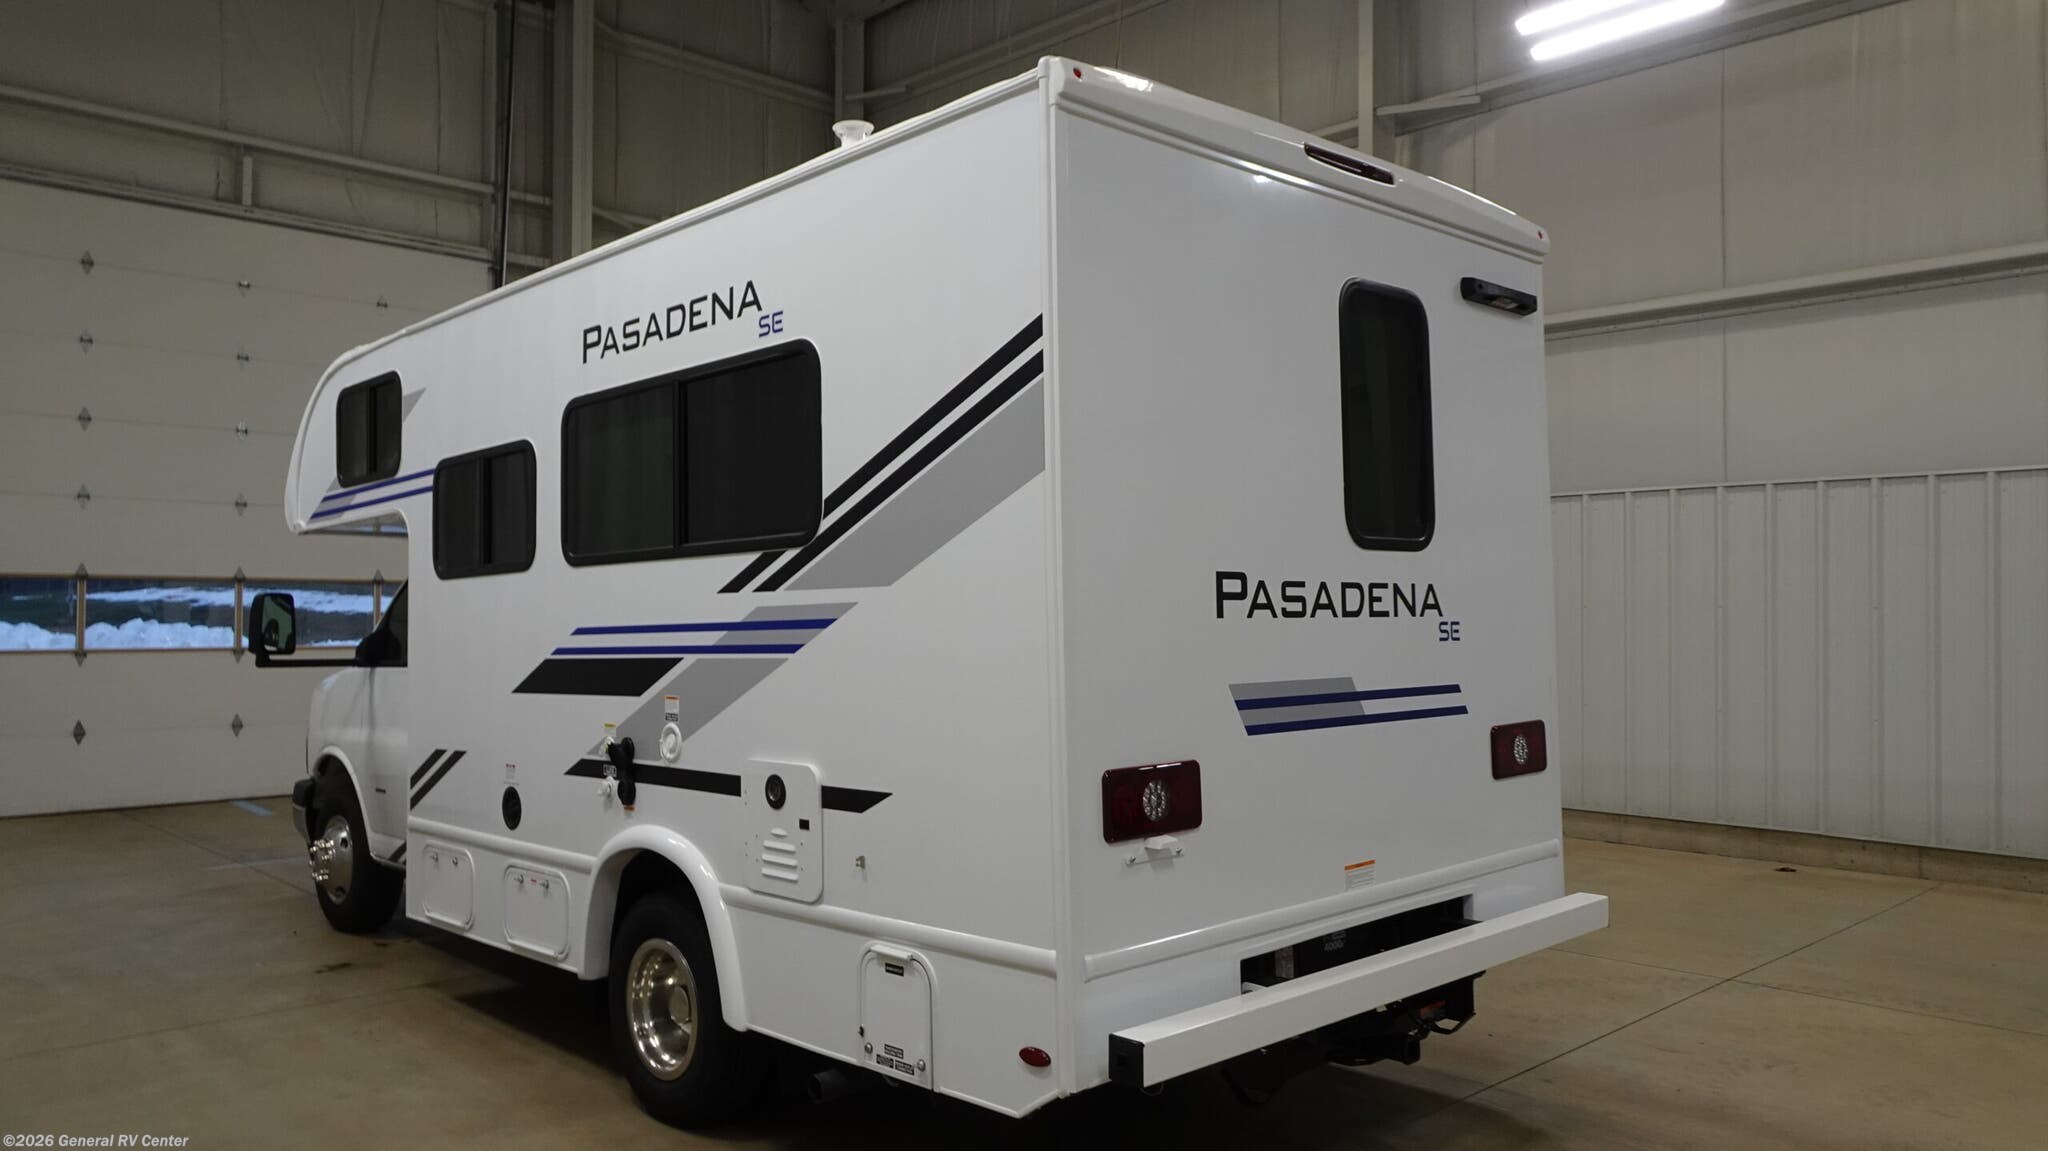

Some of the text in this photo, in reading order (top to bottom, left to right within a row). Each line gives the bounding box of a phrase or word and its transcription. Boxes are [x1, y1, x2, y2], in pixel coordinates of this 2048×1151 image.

[583, 280, 763, 364] PASADENA
[758, 310, 784, 338] SE
[1215, 571, 1443, 619] PASADENA
[1438, 621, 1461, 642] SE
